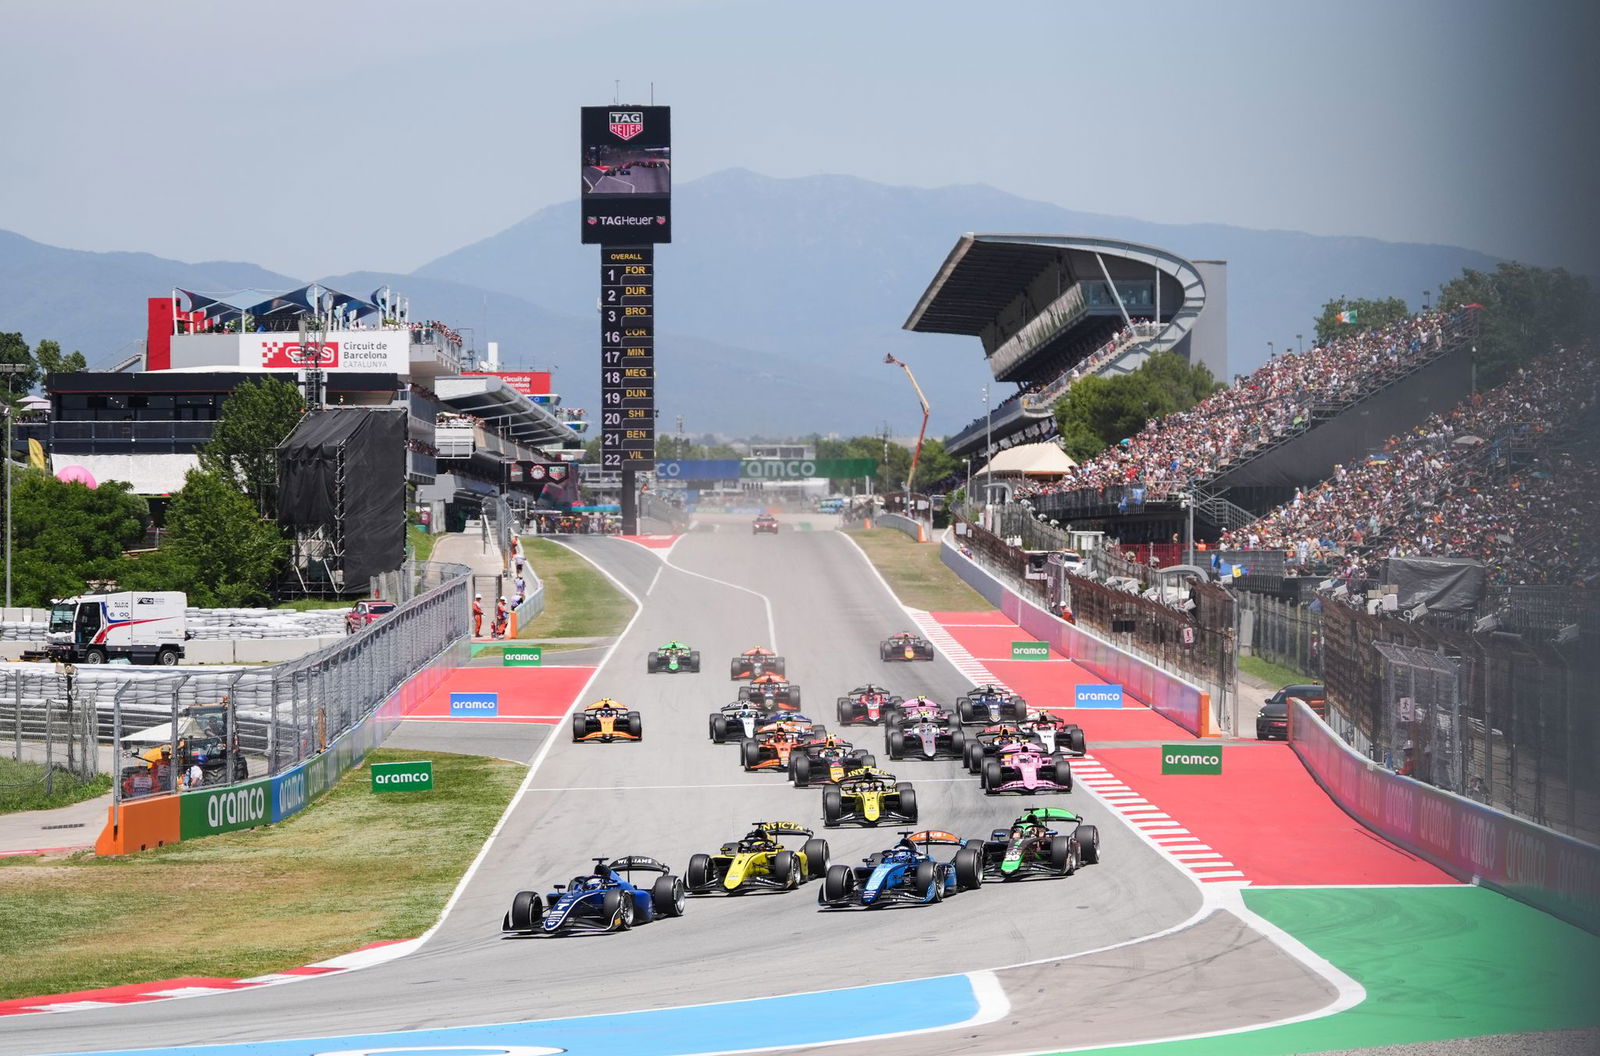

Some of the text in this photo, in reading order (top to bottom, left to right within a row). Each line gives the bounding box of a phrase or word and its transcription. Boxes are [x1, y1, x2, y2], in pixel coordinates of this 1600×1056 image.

[612, 114, 641, 123] TAG
[611, 124, 641, 138] HEUER
[608, 266, 646, 281] 1 FOR
[608, 287, 646, 301] 2 DUR
[608, 307, 646, 322] 3 BRO
[604, 331, 620, 343] 16
[343, 341, 387, 350] Circuit de
[343, 351, 388, 360] Barcelona
[604, 348, 645, 363] 17 MIN
[604, 369, 647, 384] 18 MEG
[604, 389, 647, 404] 19 DUN
[604, 410, 644, 425] 20 SHI
[604, 433, 619, 445] 21
[604, 451, 644, 466] 22 VIL
[741, 460, 816, 477] amco
[505, 653, 539, 661] aramco
[1013, 647, 1048, 655] aramco
[1078, 692, 1120, 701] aramco
[452, 701, 495, 709] aramco
[1165, 754, 1219, 765] aramco
[375, 771, 429, 784] aramco
[207, 786, 265, 828] aramco
[761, 821, 803, 831] NVICTA
[1460, 812, 1496, 871] aramco
